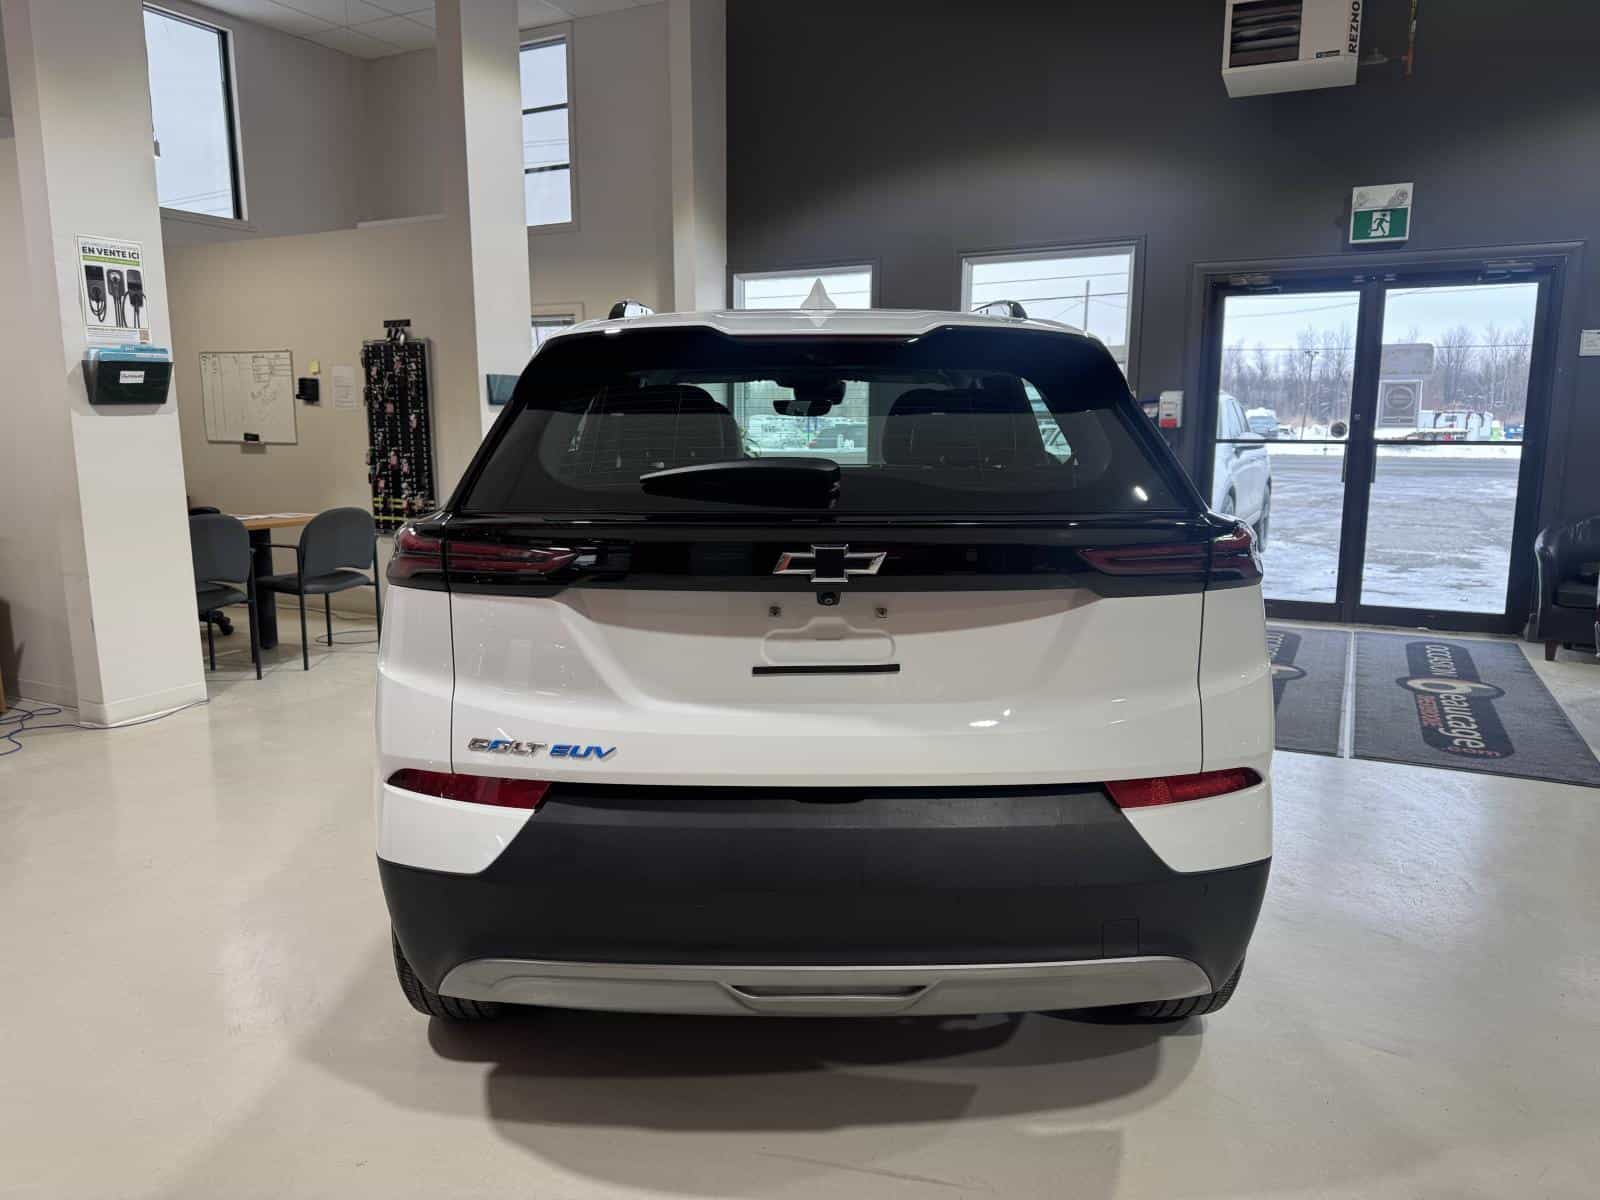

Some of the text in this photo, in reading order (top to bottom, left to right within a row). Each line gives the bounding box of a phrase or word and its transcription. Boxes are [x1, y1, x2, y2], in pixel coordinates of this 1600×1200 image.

[82, 246, 95, 254] EN
[96, 248, 127, 258] VENTE
[128, 252, 140, 260] ICI
[1425, 644, 1459, 677] OCCASION
[468, 738, 616, 759] BOLT EUV
